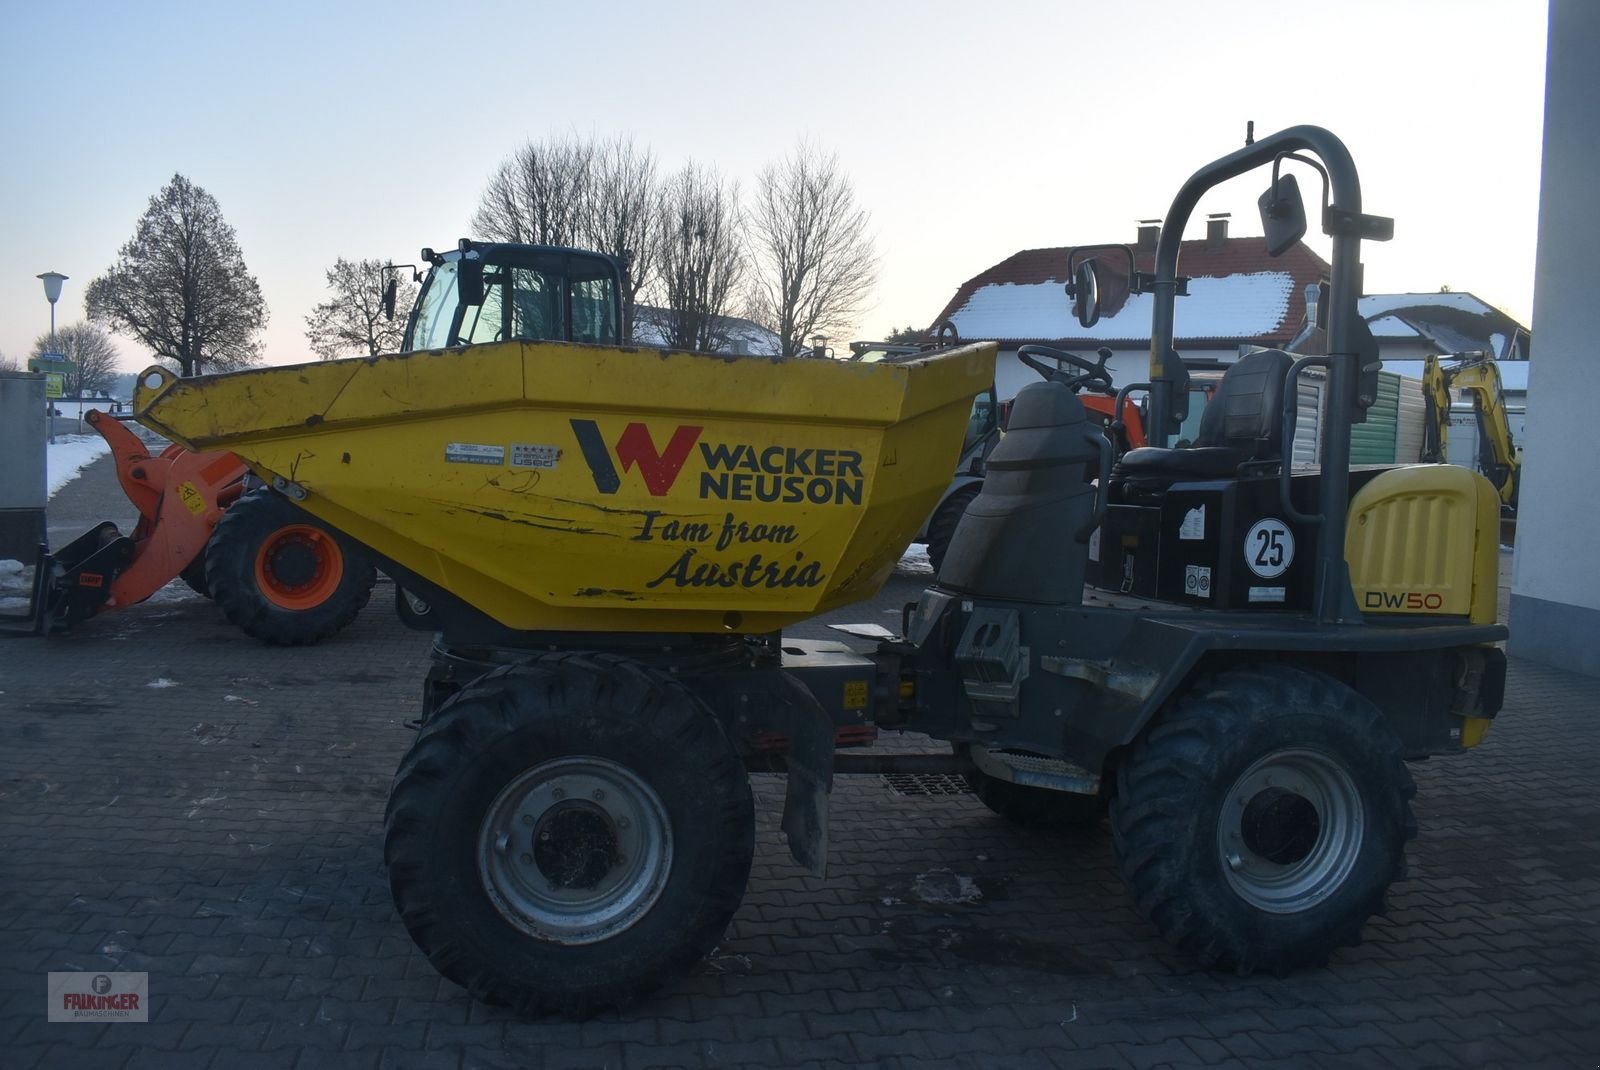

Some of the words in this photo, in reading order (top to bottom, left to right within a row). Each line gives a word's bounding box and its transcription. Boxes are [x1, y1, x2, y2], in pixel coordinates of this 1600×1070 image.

[698, 442, 864, 478] WACKER
[700, 472, 864, 506] NEUSON
[716, 512, 799, 551] from
[1255, 529, 1284, 567] 25
[646, 548, 826, 588] Austria
[1365, 592, 1442, 609] DW50
